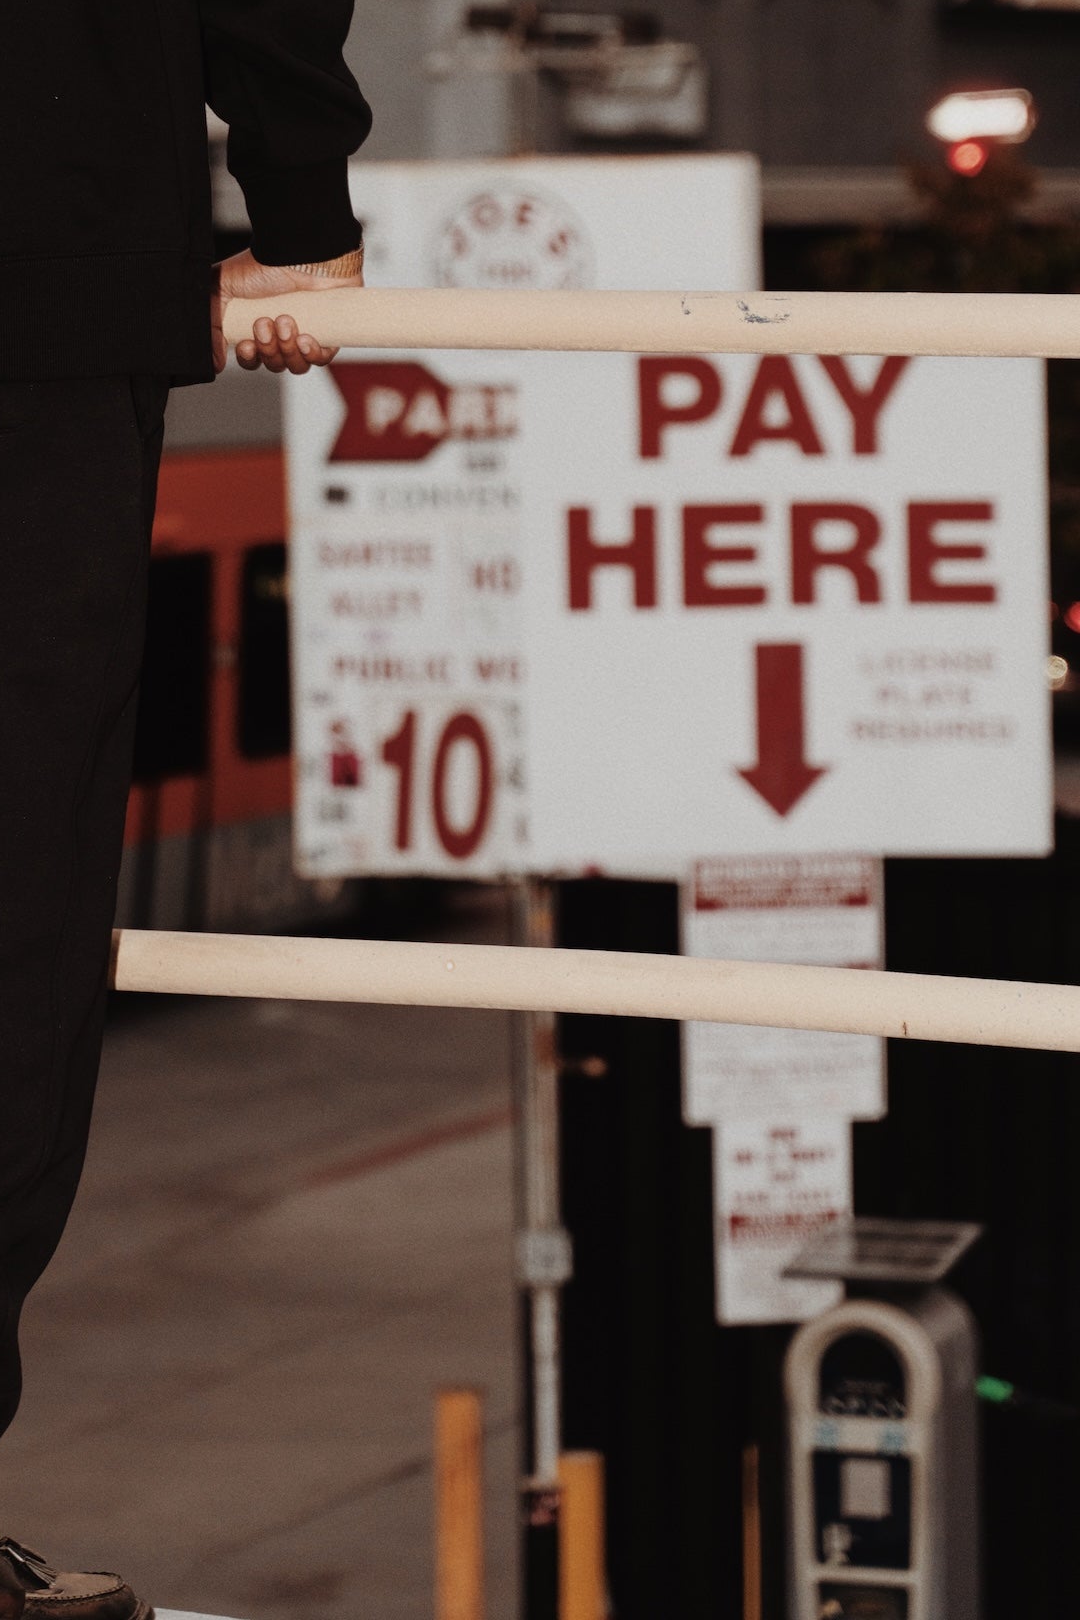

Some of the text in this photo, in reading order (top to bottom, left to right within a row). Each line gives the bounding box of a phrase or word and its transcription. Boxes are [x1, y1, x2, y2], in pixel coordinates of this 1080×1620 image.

[637, 355, 917, 459] PAY
[566, 500, 998, 612] HERE
[381, 710, 491, 863] 10
